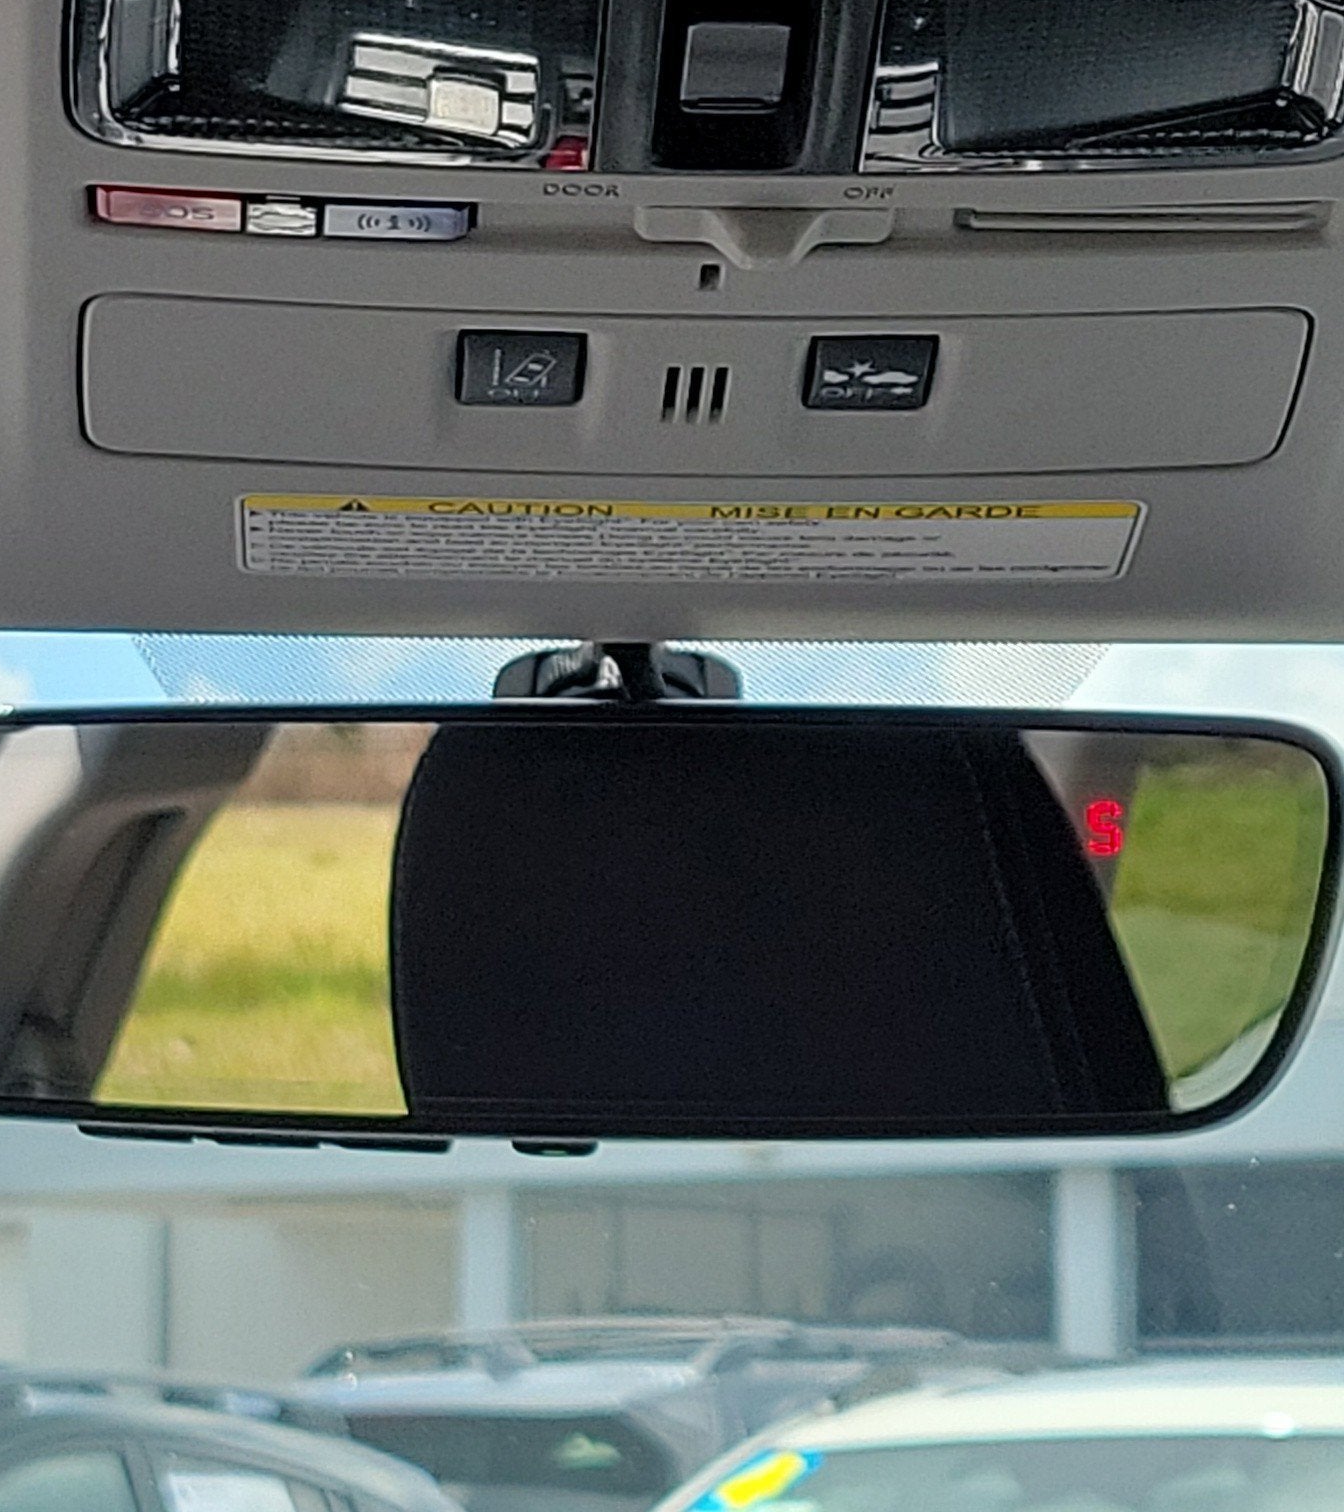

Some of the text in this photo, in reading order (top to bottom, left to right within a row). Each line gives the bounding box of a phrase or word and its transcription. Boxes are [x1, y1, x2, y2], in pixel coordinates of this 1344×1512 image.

[542, 183, 620, 198] DOOR
[842, 186, 895, 200] OFF
[428, 500, 614, 518] CAUTION
[709, 505, 808, 520] MISE
[825, 505, 881, 520] EN
[894, 504, 1041, 520] GARDE
[1084, 799, 1125, 857] S
